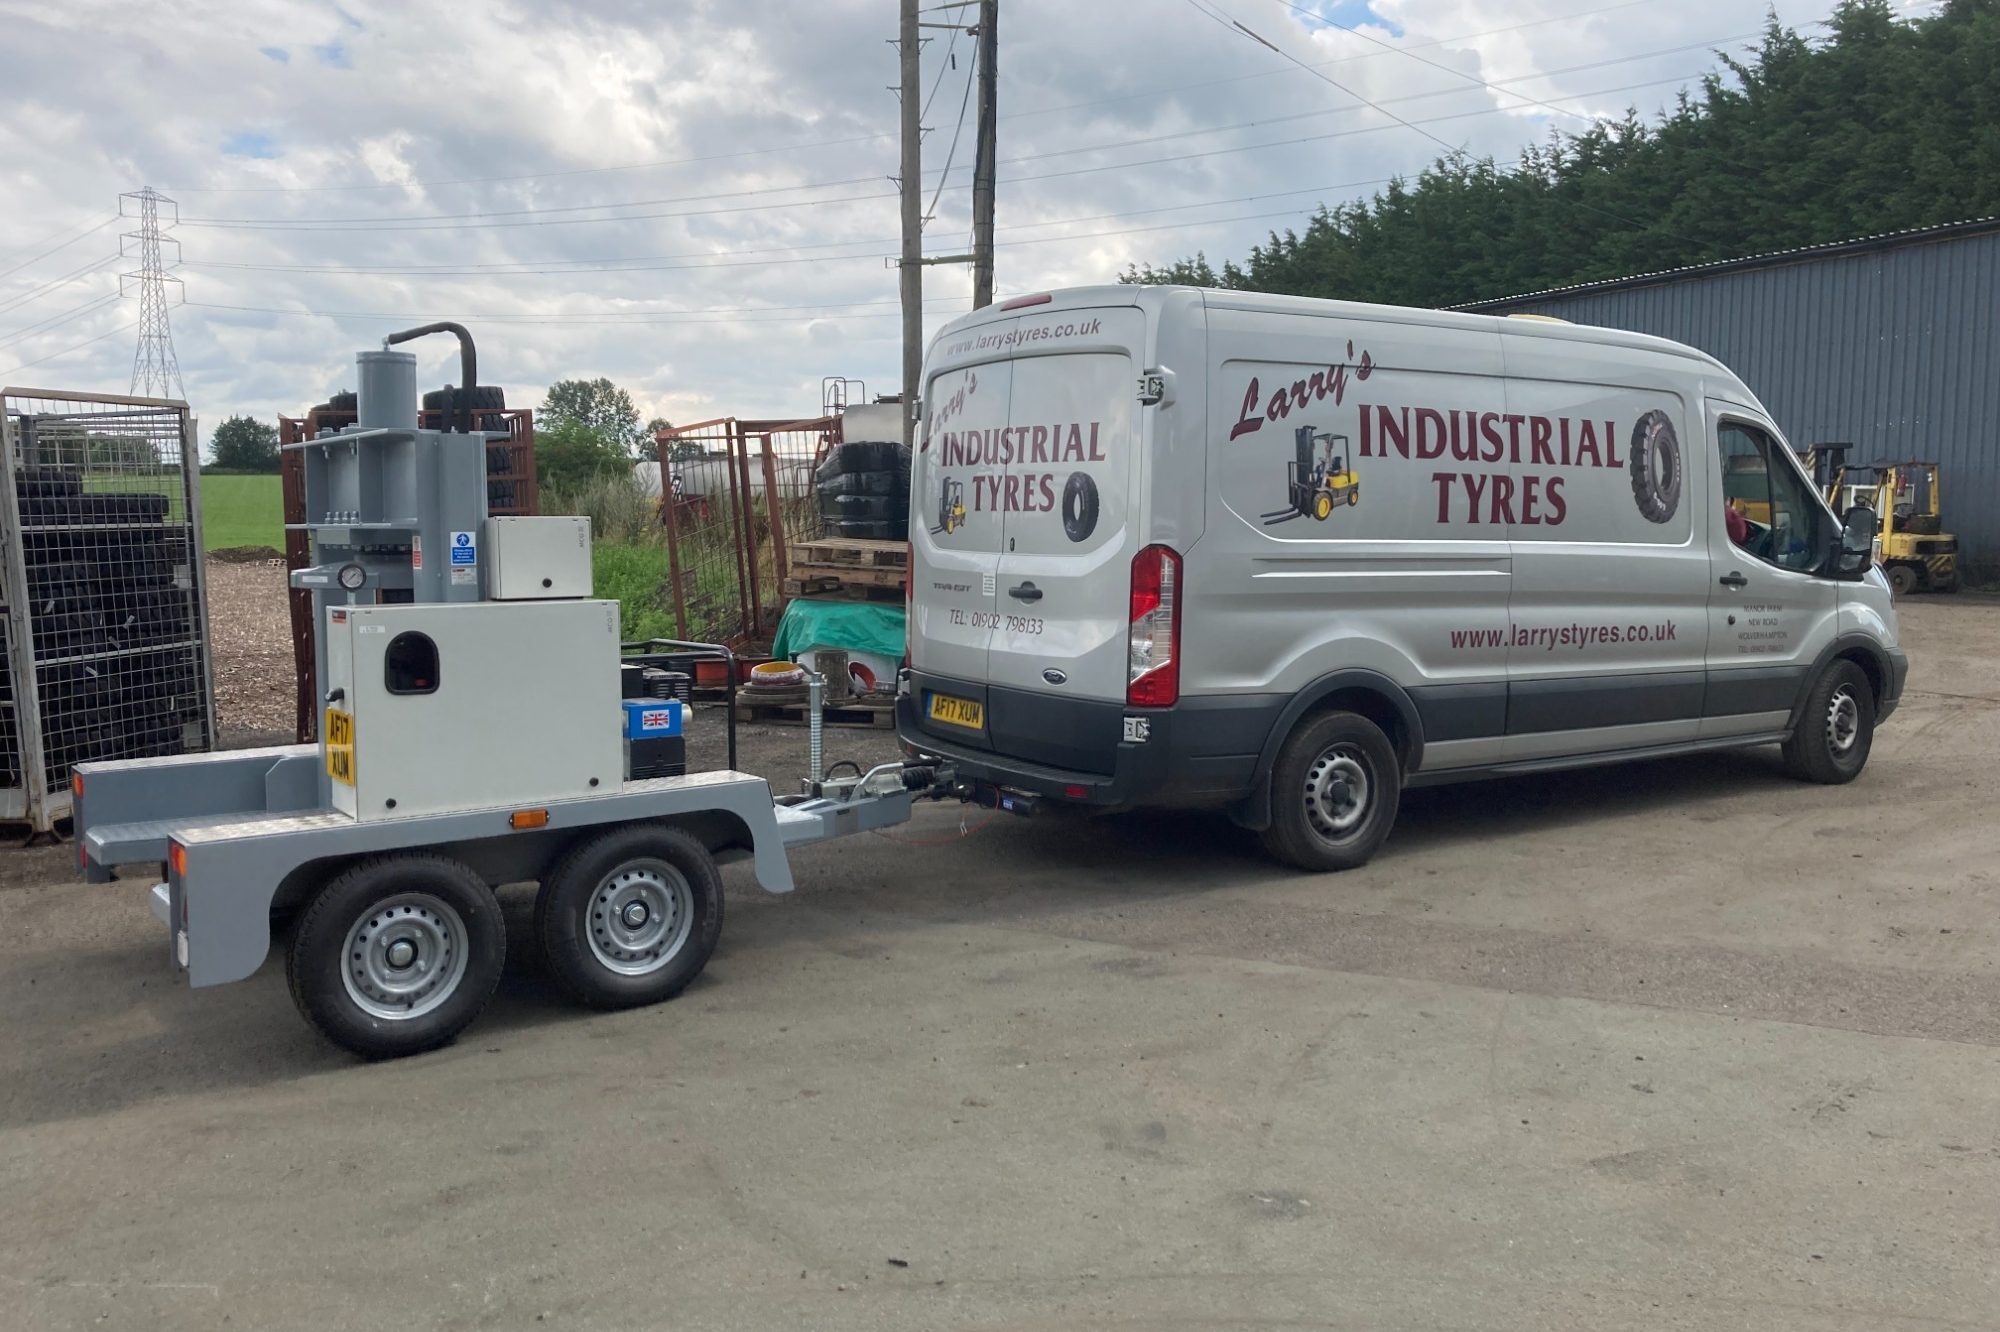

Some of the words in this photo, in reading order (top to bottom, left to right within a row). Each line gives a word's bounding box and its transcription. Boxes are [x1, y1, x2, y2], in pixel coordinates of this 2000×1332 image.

[946, 318, 1101, 356] www.larrystyres.co.uk
[1230, 339, 1376, 441] Larry's
[942, 422, 1106, 467] INDUSTRIAL
[1358, 403, 1624, 468] INDUSTRIAL
[972, 473, 1055, 512] TYRES
[1432, 472, 1567, 526] TYRES
[949, 608, 968, 625] TEL:
[971, 611, 1000, 629] 01902
[1005, 615, 1044, 635] 798133
[1450, 619, 1677, 651] www.larrystyres.co.uk
[330, 712, 349, 745] AF17
[934, 696, 957, 718] AF17
[958, 702, 980, 724] XUM
[331, 746, 349, 780] XUM
